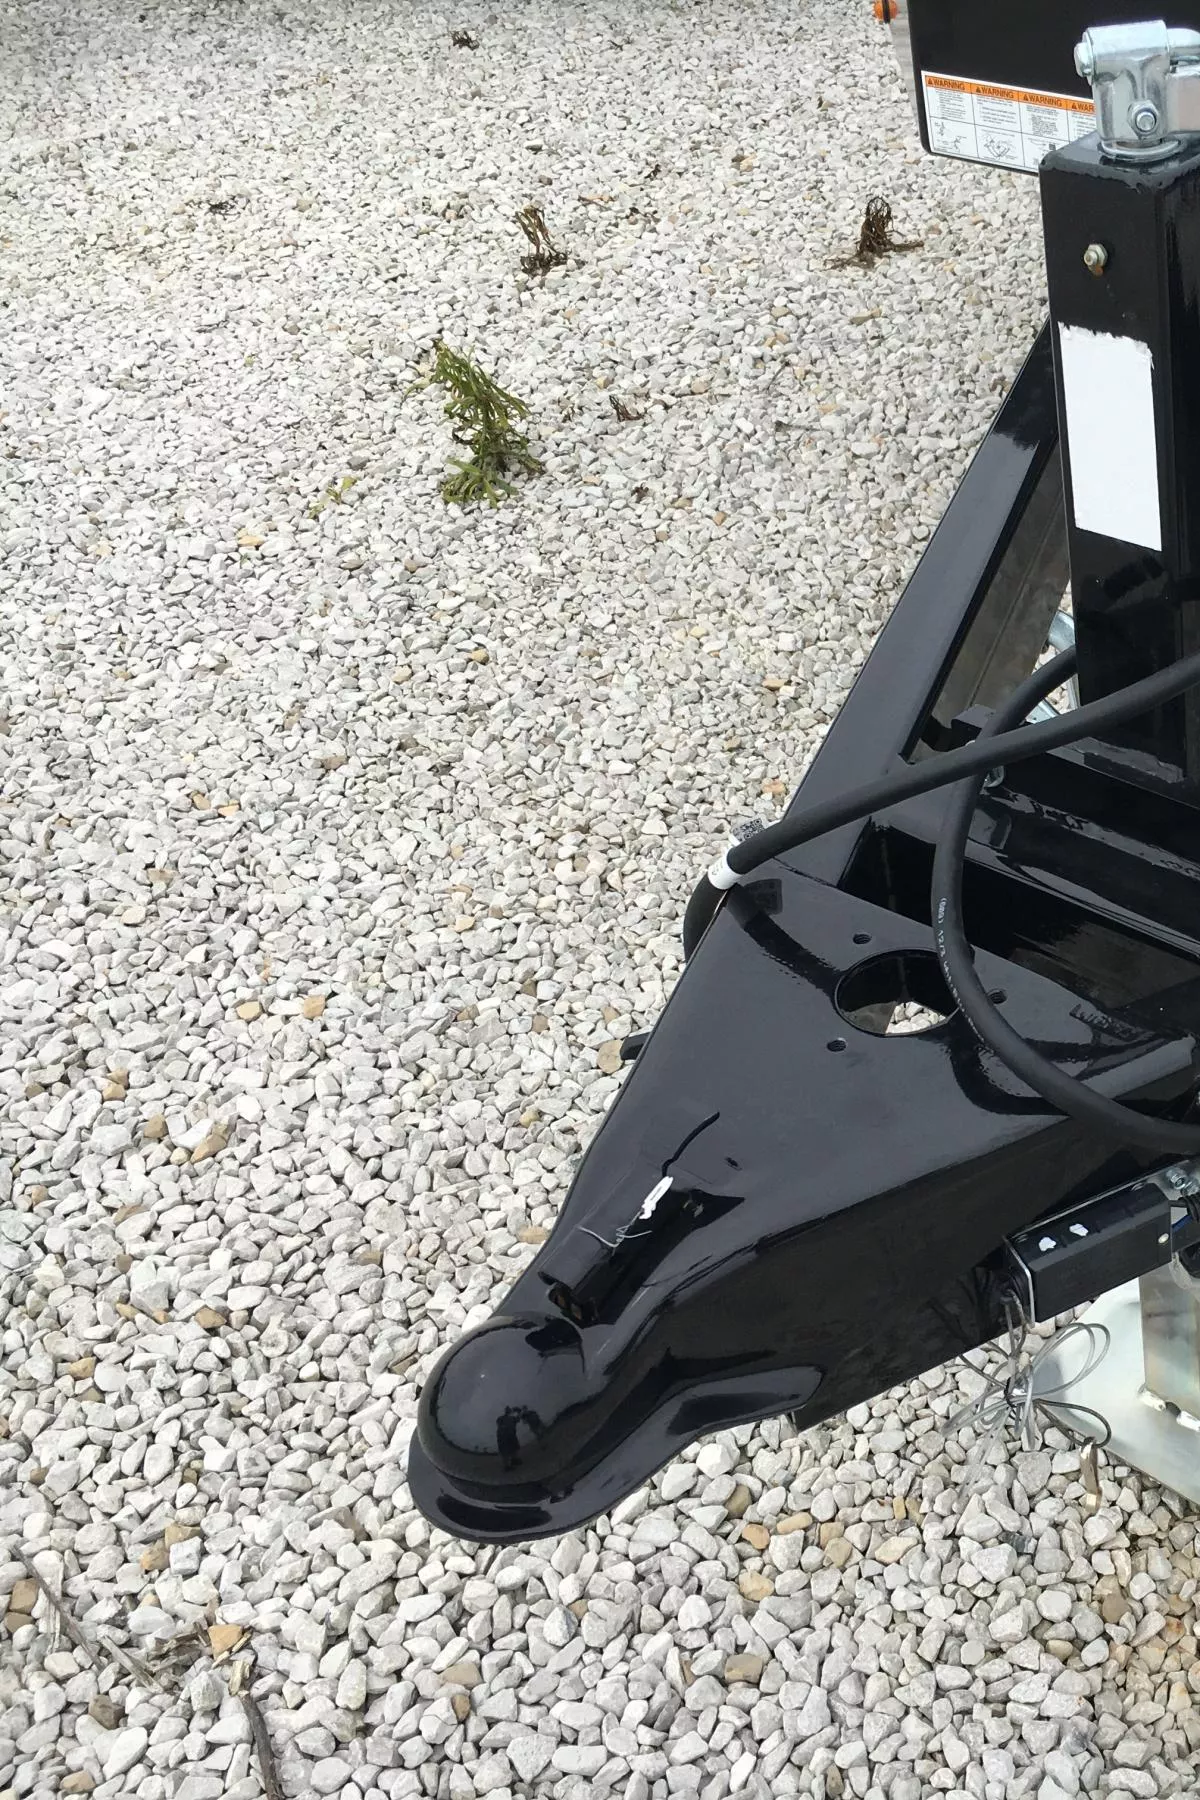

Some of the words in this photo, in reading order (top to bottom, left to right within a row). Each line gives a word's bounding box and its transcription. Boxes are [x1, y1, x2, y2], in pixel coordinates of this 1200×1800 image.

[932, 78, 966, 91] WARNING
[980, 86, 1014, 99] WARNING
[1028, 94, 1063, 108] WARNING
[1077, 102, 1096, 112] WAR
